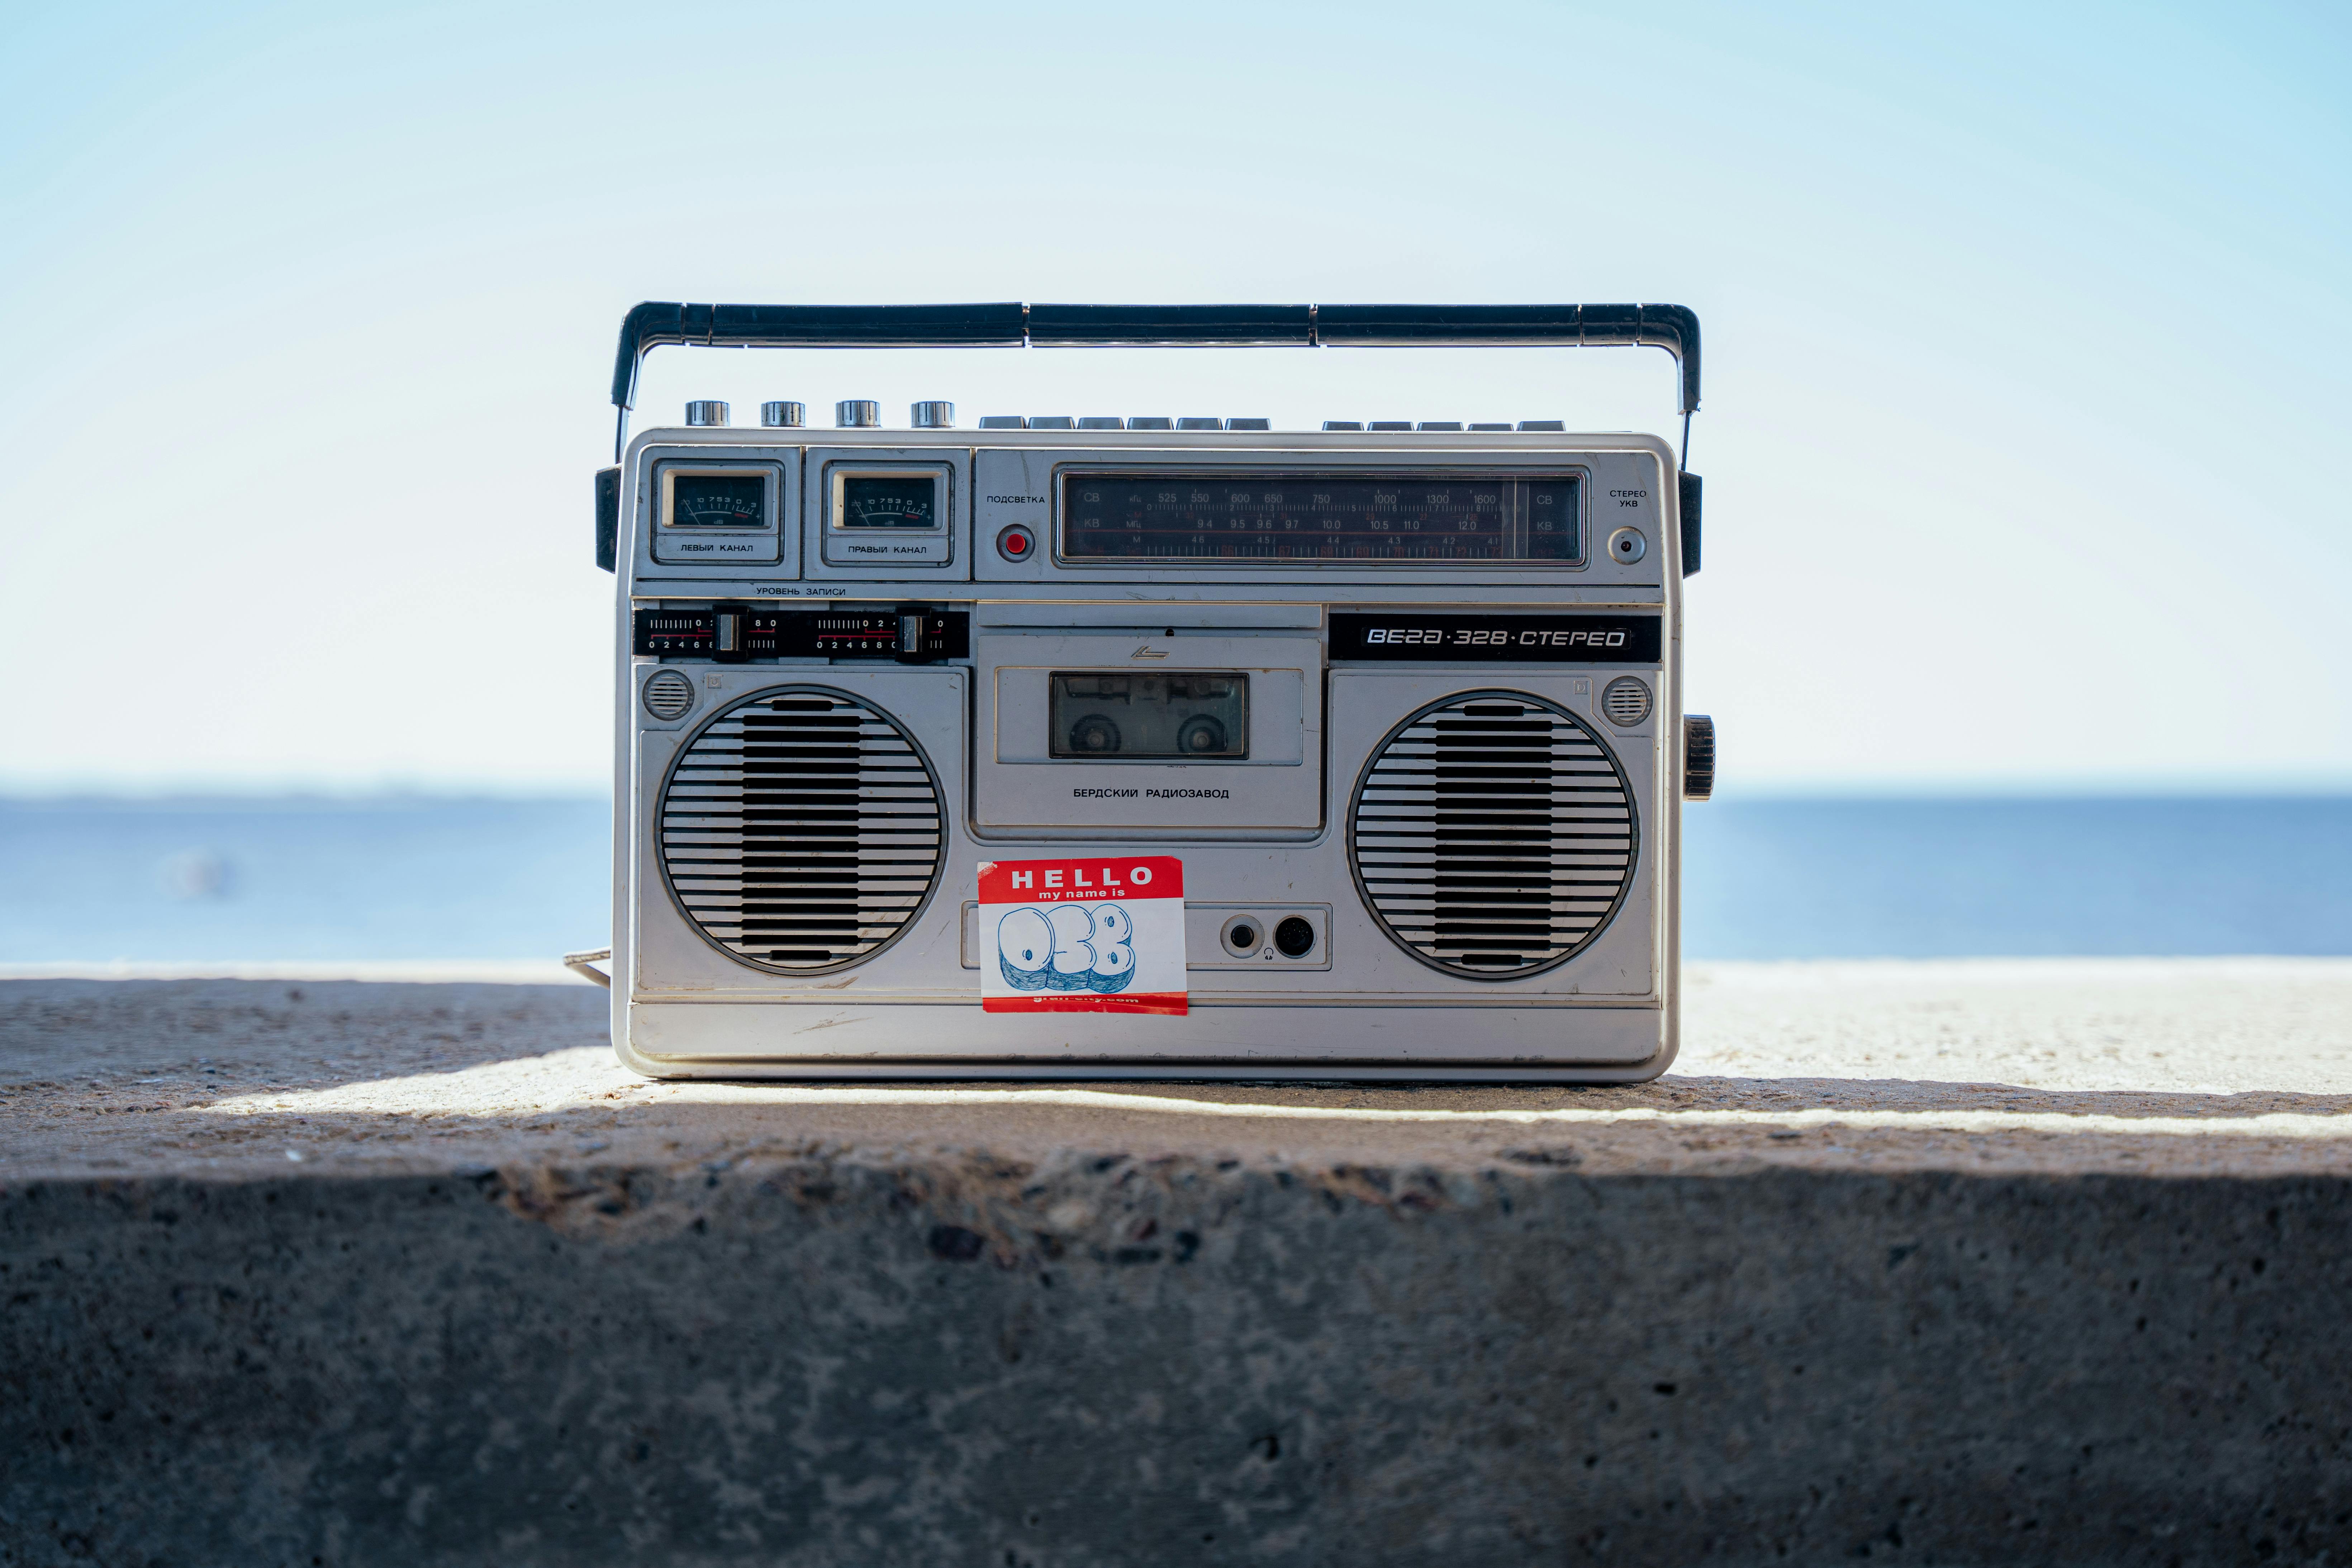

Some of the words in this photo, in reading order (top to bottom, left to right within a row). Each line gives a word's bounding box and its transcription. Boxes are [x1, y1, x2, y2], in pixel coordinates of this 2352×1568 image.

[1084, 493, 1099, 502] СВ
[1159, 494, 1176, 502] 525
[1191, 494, 1209, 502] 550
[1231, 494, 1250, 503] 600
[1264, 494, 1282, 503] 650
[1313, 495, 1330, 503] 750
[1374, 495, 1396, 503] 1000
[1427, 495, 1449, 504] 1300
[1474, 495, 1496, 504] 1600
[1537, 495, 1552, 504] СВ
[1084, 519, 1099, 527] КВ
[1197, 519, 1212, 528] 9.4
[1230, 520, 1245, 528] 9.5
[1257, 520, 1272, 528] 9.6
[1286, 520, 1298, 529] 9.7
[1323, 520, 1340, 529] 10.0
[1370, 521, 1388, 529] 10.5
[1404, 521, 1419, 529] 11.0
[1458, 521, 1476, 530] 12.0
[1537, 522, 1552, 530] КВ
[1074, 789, 1138, 798] БЕРДСКИЙ
[1146, 789, 1229, 799] РАДИОЗАВОД
[1012, 867, 1152, 889] HELLO
[1039, 891, 1060, 900] my
[1066, 890, 1107, 898] name
